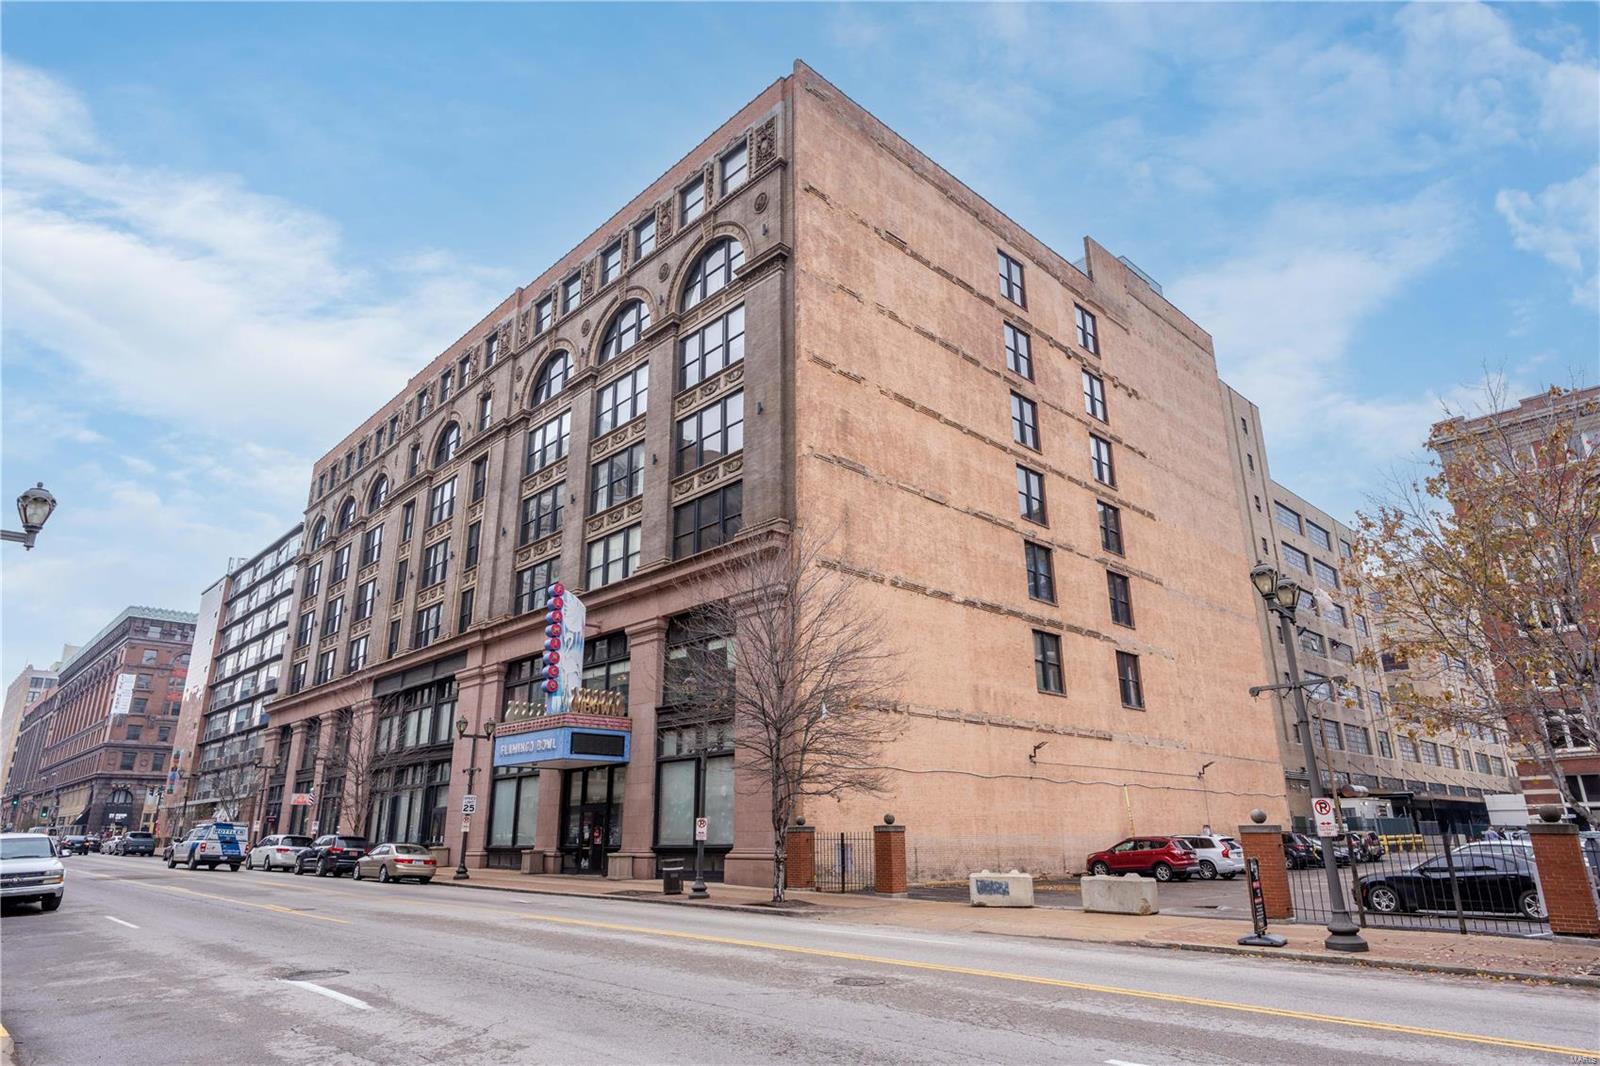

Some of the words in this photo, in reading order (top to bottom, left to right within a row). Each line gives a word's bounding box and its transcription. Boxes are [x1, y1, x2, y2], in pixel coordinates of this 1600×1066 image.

[500, 740, 534, 755] FLAMINGO
[536, 738, 557, 751] BOWL
[463, 804, 475, 812] 25
